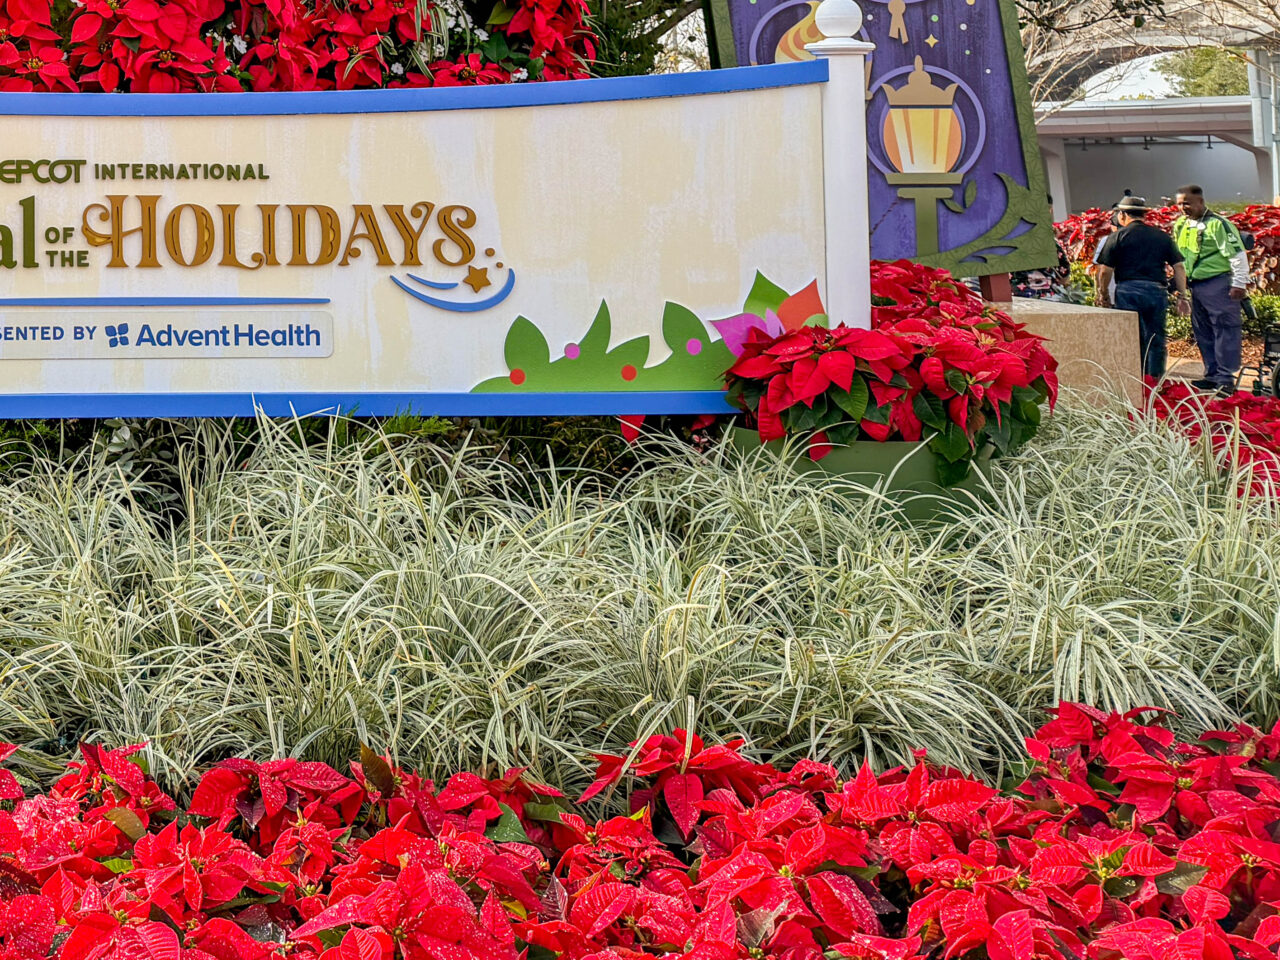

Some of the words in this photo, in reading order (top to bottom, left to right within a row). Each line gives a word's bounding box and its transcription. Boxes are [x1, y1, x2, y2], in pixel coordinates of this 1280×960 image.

[94, 163, 269, 181] INTERNATIONAL
[45, 226, 75, 244] OF
[82, 194, 477, 270] HOLIDAYS
[46, 250, 90, 267] THE
[73, 326, 97, 341] BY
